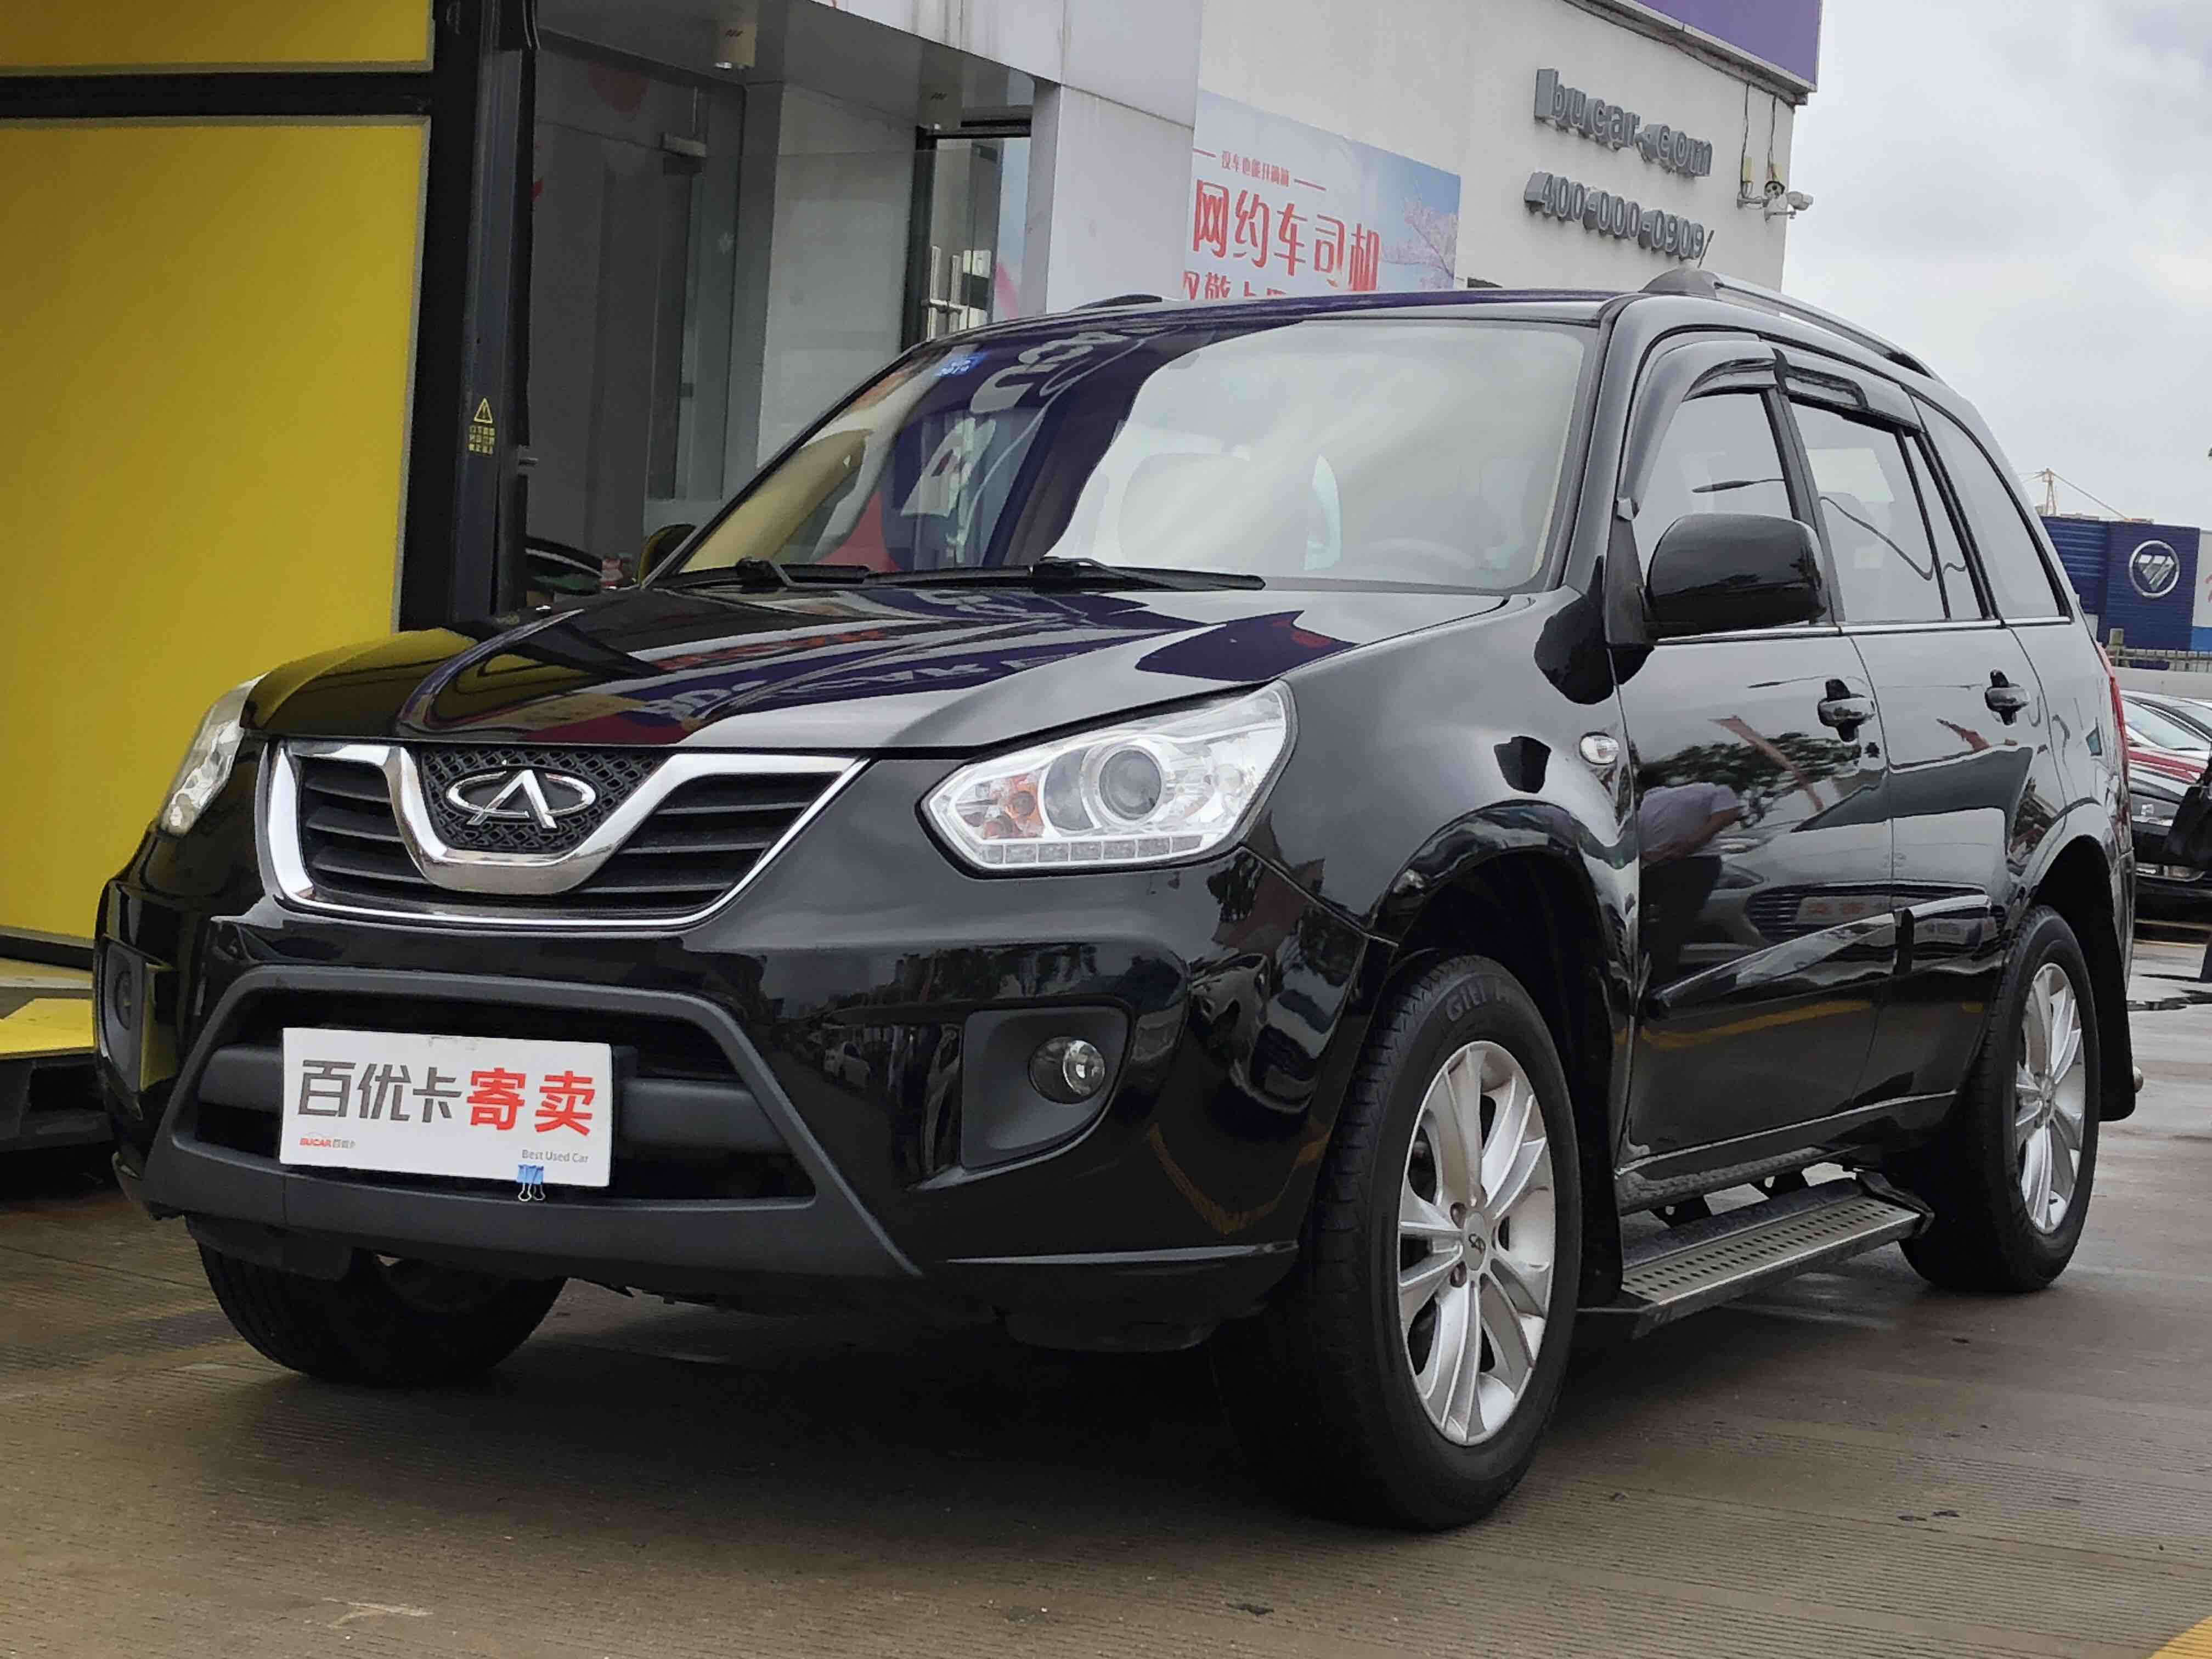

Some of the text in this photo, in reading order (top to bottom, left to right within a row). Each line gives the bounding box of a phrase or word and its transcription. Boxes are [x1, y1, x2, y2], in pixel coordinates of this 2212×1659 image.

[1534, 67, 1712, 177] bucar.com
[1193, 179, 1380, 291] 网约车司机
[1524, 171, 1705, 259] 400-000-0909
[297, 1059, 596, 1136] 百优卡寄卖
